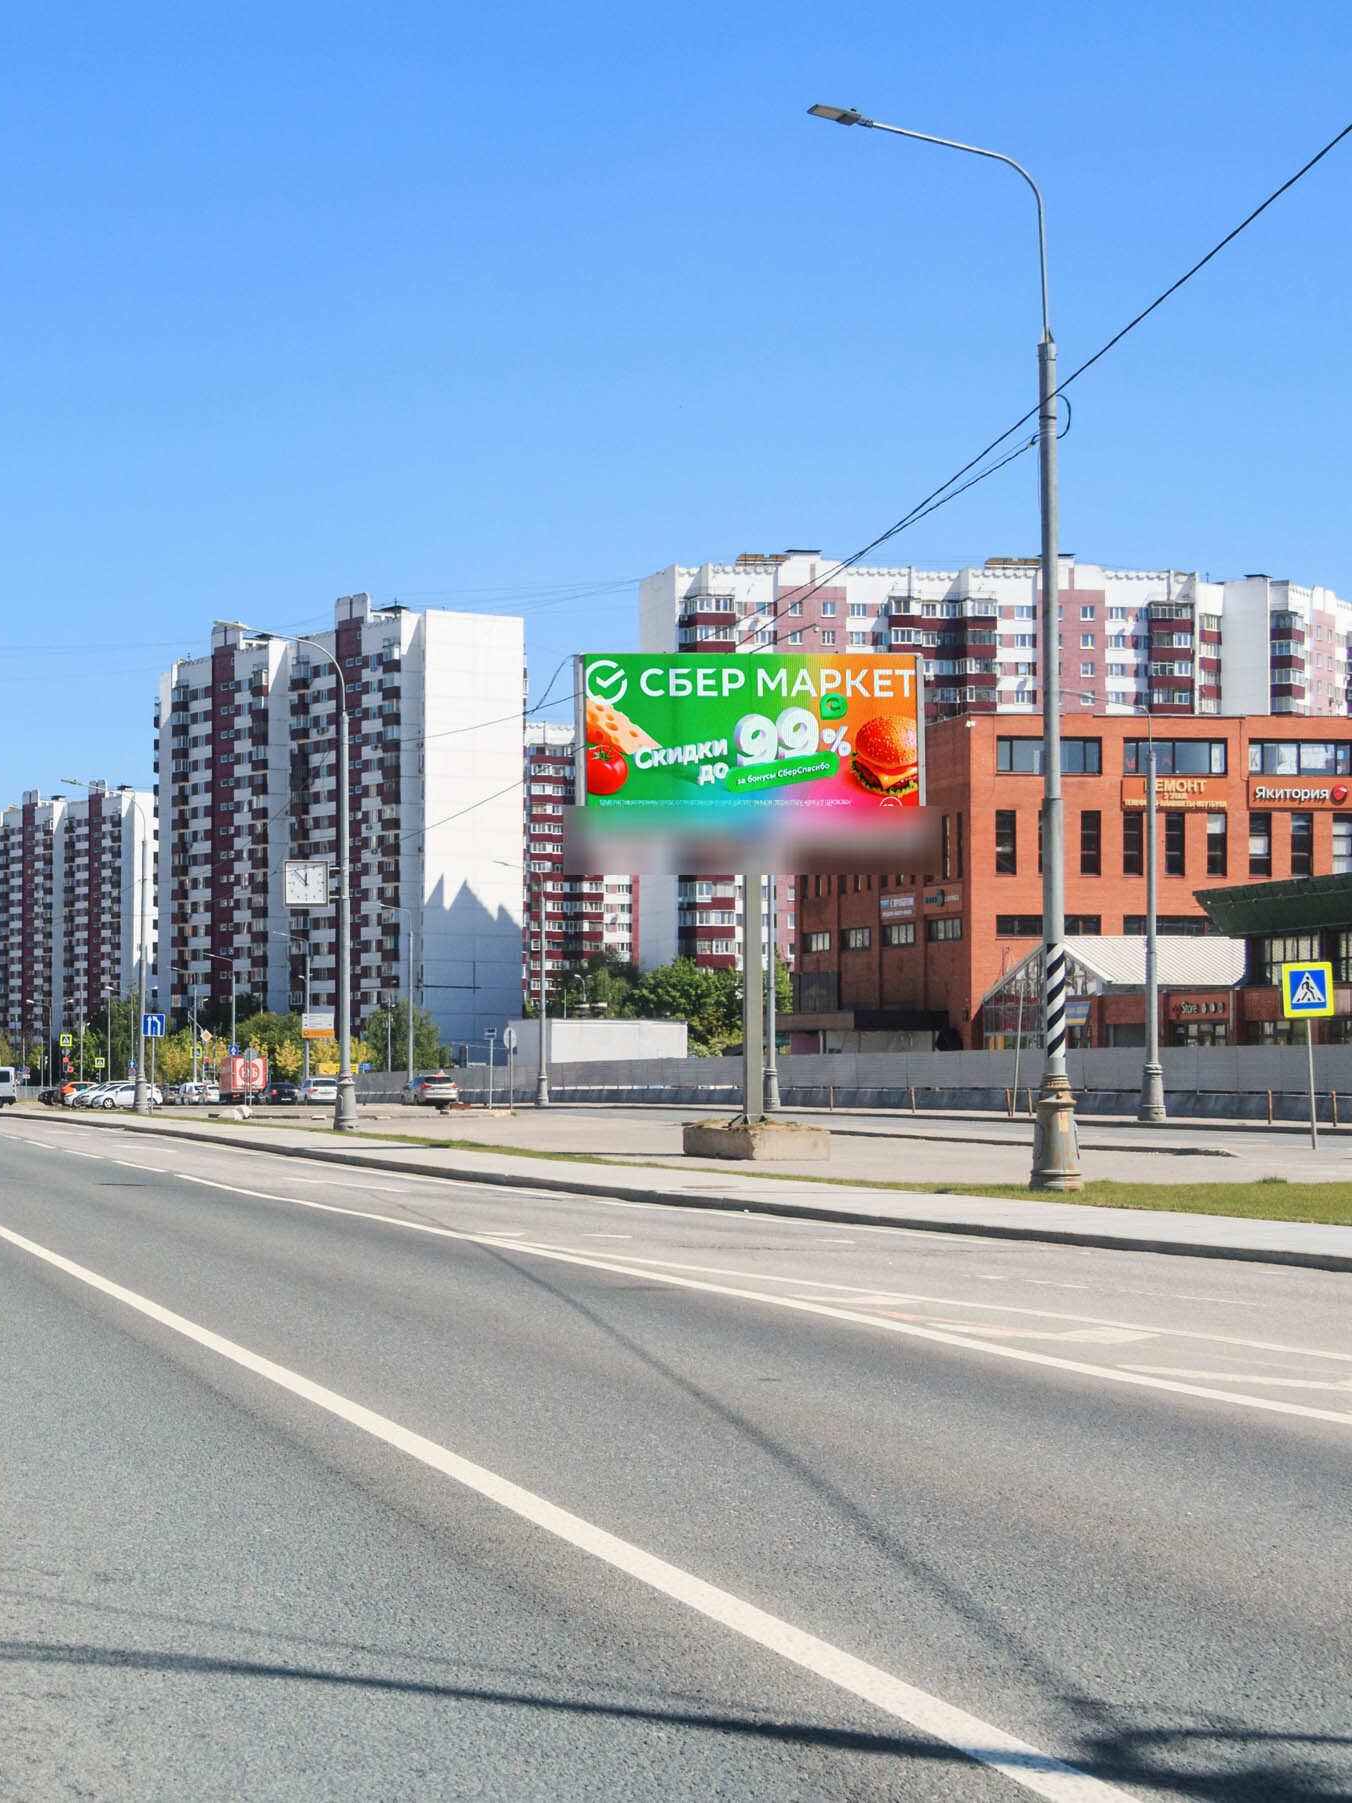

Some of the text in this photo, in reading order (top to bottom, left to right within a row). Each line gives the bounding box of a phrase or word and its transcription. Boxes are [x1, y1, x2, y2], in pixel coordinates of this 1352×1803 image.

[640, 668, 916, 697] СБЕР МАРКЕТ
[633, 738, 728, 770] Скидки
[698, 761, 730, 786] до
[747, 772, 776, 784] бонусы
[1145, 779, 1207, 793] ЕМОНТ
[1255, 785, 1329, 802] Якитория
